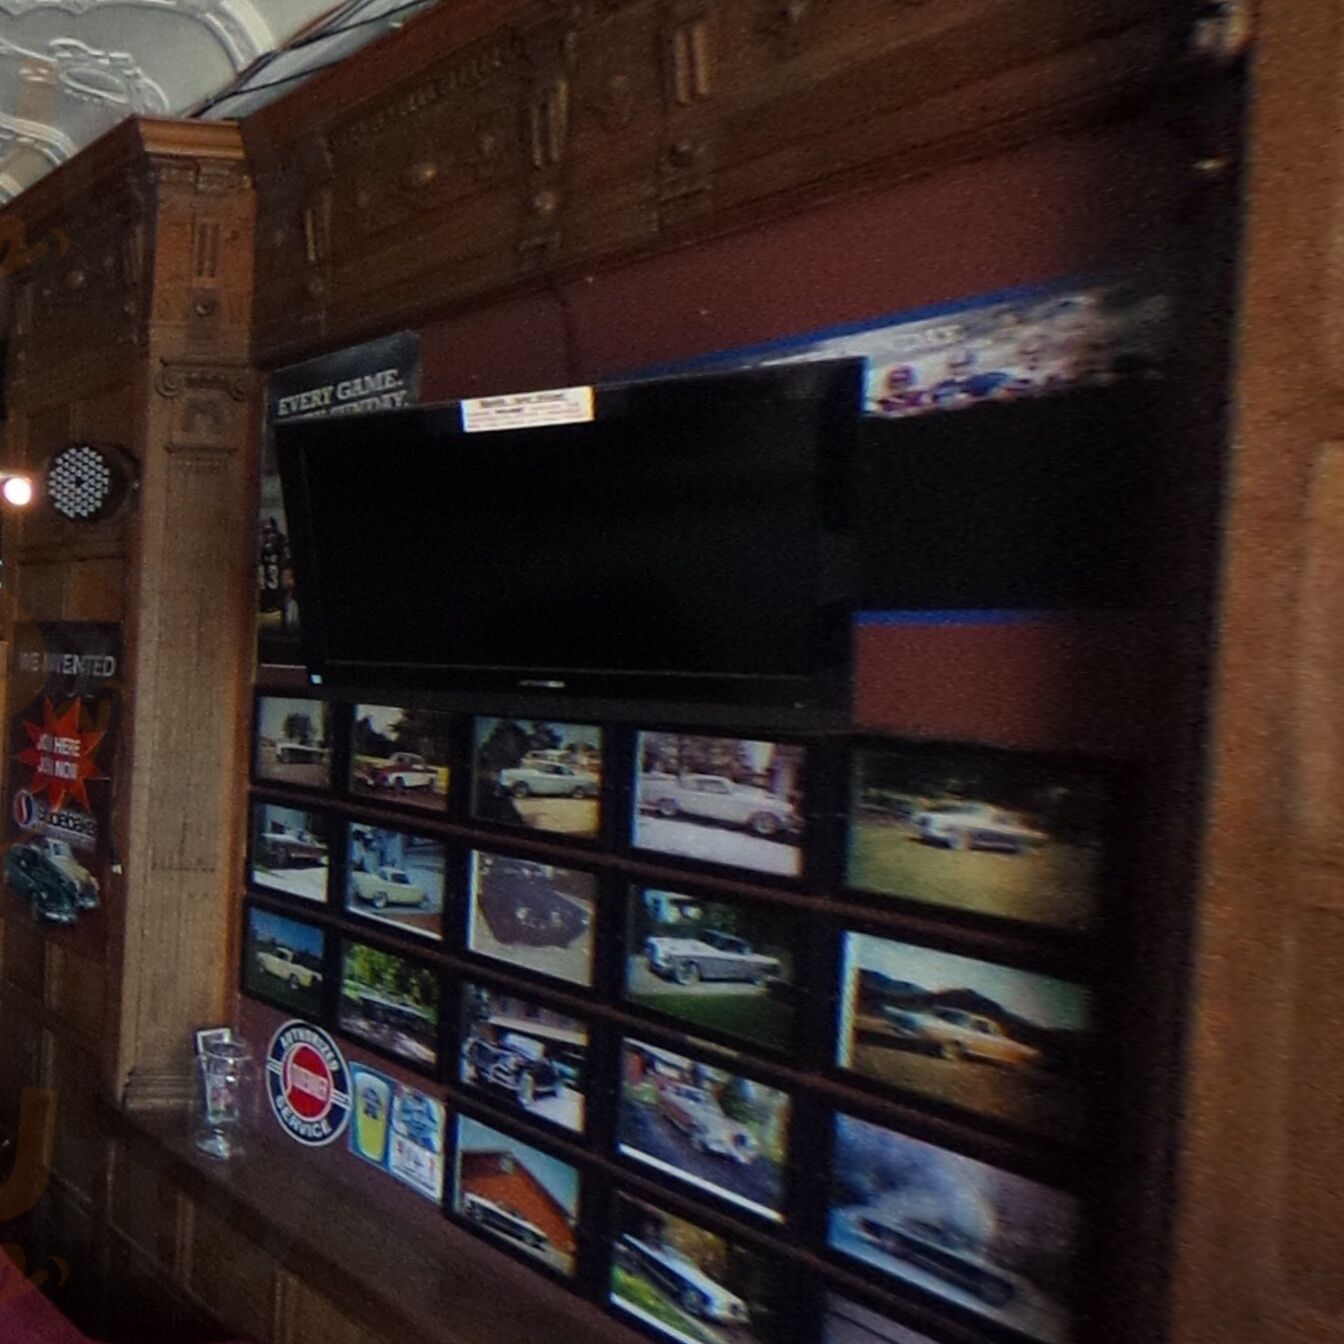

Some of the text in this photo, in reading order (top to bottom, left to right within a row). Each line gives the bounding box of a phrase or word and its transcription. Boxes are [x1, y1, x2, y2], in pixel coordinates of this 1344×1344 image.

[277, 385, 334, 416] EVERY
[336, 368, 403, 400] GAME.
[55, 736, 80, 757] HERE
[279, 1026, 341, 1072] AUTHORIZED
[276, 1094, 333, 1139] SERVICE
